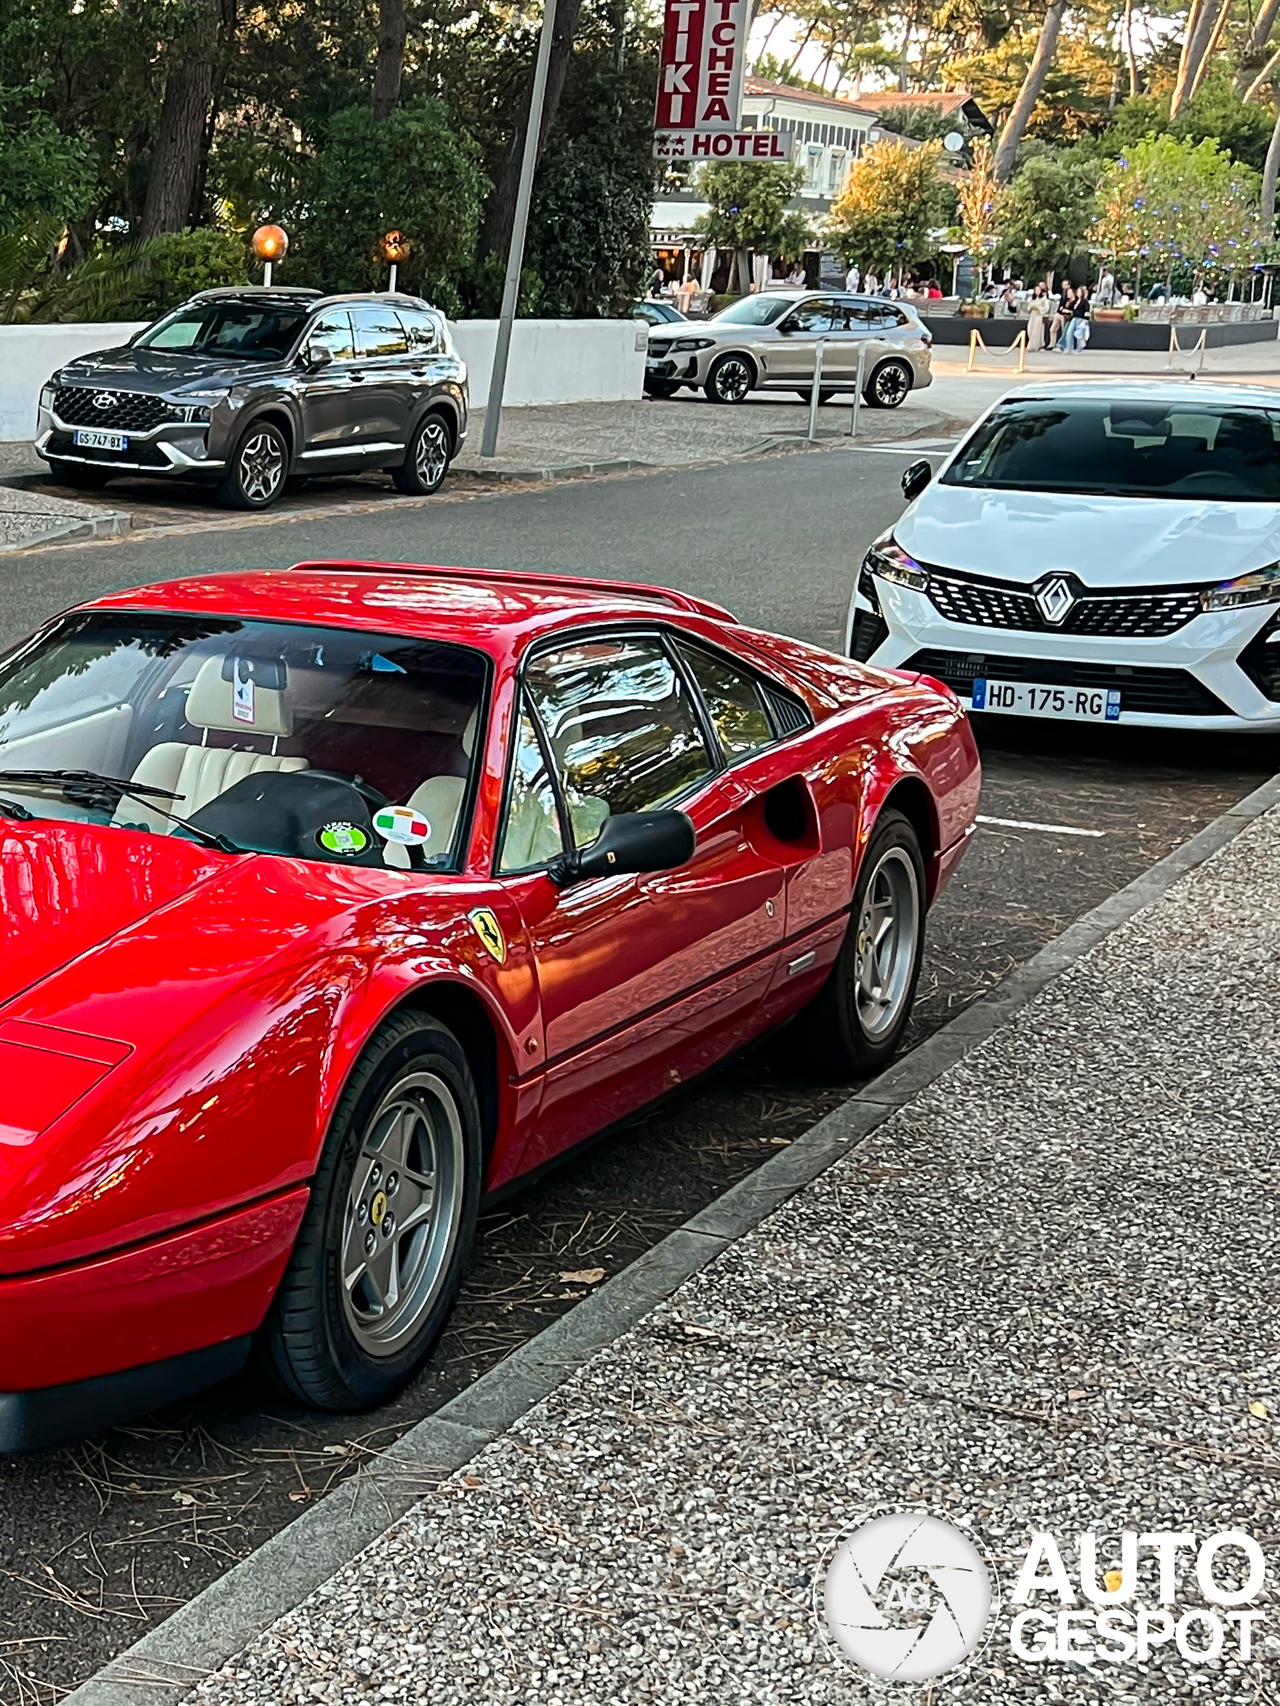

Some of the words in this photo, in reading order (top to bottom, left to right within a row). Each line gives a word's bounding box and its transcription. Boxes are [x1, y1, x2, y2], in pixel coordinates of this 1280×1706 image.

[664, 0, 700, 123] TIKI
[692, 134, 785, 157] HOTEL
[988, 685, 1103, 715] HD-175-RG
